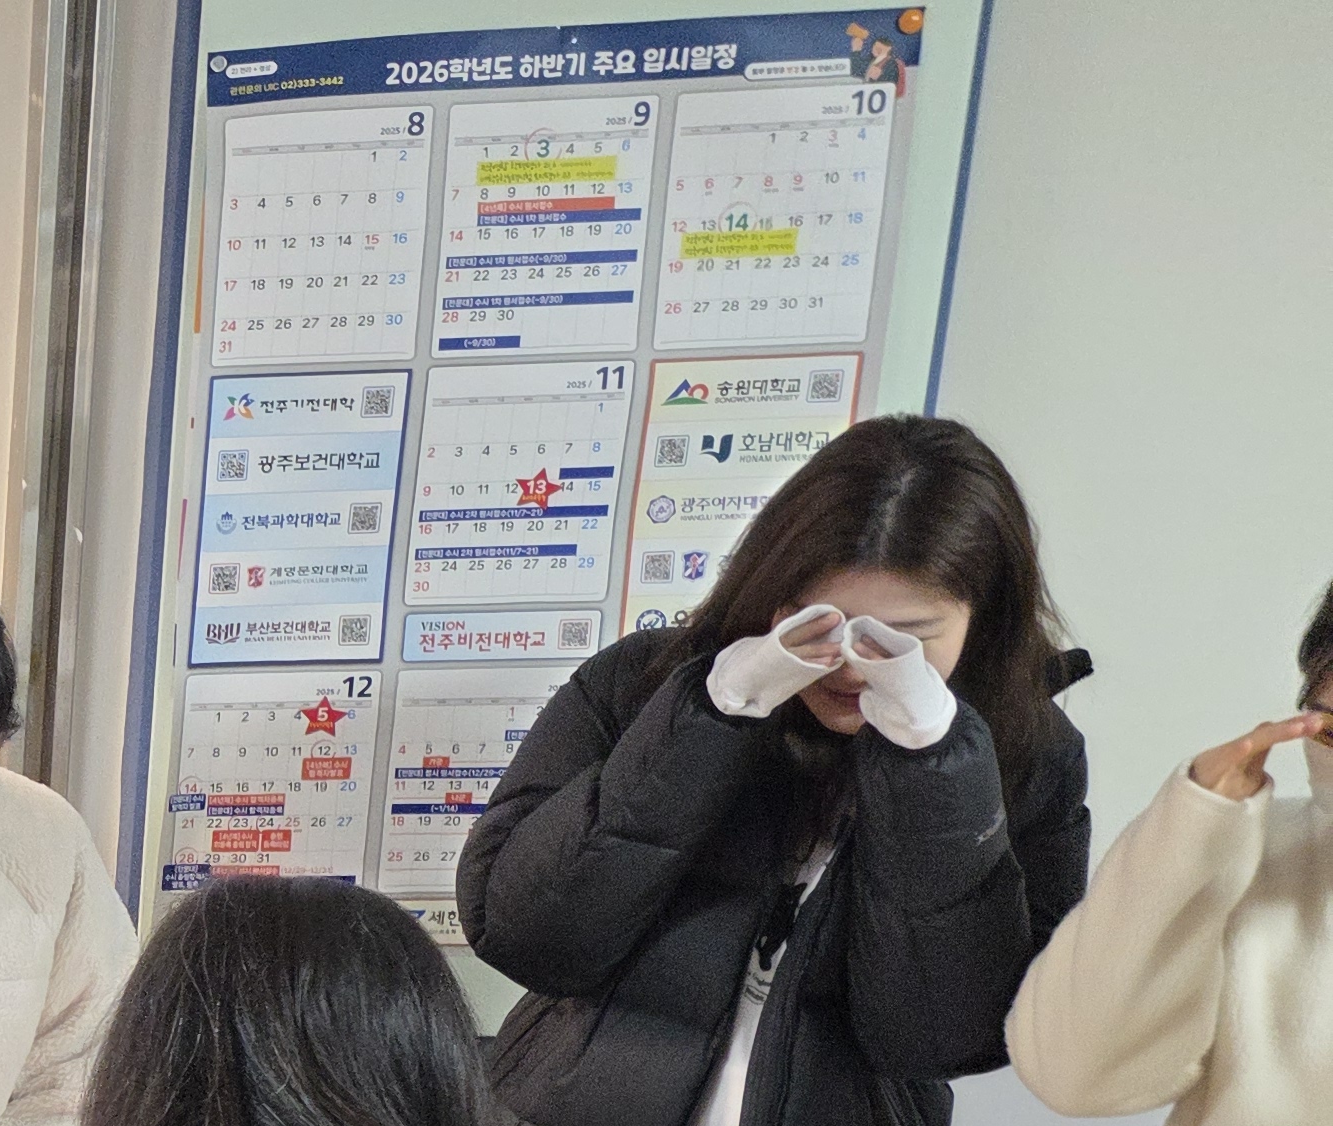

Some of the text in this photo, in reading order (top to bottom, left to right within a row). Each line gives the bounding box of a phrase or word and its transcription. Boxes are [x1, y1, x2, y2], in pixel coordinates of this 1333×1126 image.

[386, 44, 737, 85] 2026학년도 하반기 주요 입시일정
[281, 77, 344, 89] 02)333-3442
[852, 89, 886, 115] 10
[634, 101, 650, 126] 9
[408, 112, 424, 136] 8
[372, 150, 407, 162] 1 2
[537, 140, 550, 157] 3
[725, 213, 748, 231] 14
[227, 233, 407, 251] 10 11 12 13 14 15 16
[224, 273, 405, 291] 17 18 19 20 21 22 23
[665, 297, 823, 314] 26 27 28 29 30 31
[221, 314, 403, 332] 24 25 26 27 28 29 30
[219, 341, 232, 353] 31
[597, 366, 624, 390] 11
[717, 378, 800, 396] 송원대학교
[260, 397, 355, 413] 전주기전대학
[598, 403, 603, 412] 1
[738, 431, 829, 452] 호남대학교
[258, 452, 380, 473] 광주보건대학교
[527, 480, 546, 495] 13
[241, 512, 342, 531] 전북과학대학교
[419, 519, 598, 534] 16 17 18 19 20 21 22
[270, 564, 368, 577] 계명문화대학교
[415, 557, 594, 573] 23 24 25 26 27 28 29
[207, 622, 241, 640] BHU
[246, 620, 331, 635] 부산보건대학교
[420, 621, 465, 631] VISION
[419, 631, 546, 653] 전주비전대학교
[342, 676, 372, 698] 12
[318, 707, 329, 722] 5
[340, 781, 356, 791] 20
[207, 816, 352, 828] 22 26 27
[203, 853, 270, 863] 29 30 31
[388, 851, 456, 862] 25 26 27
